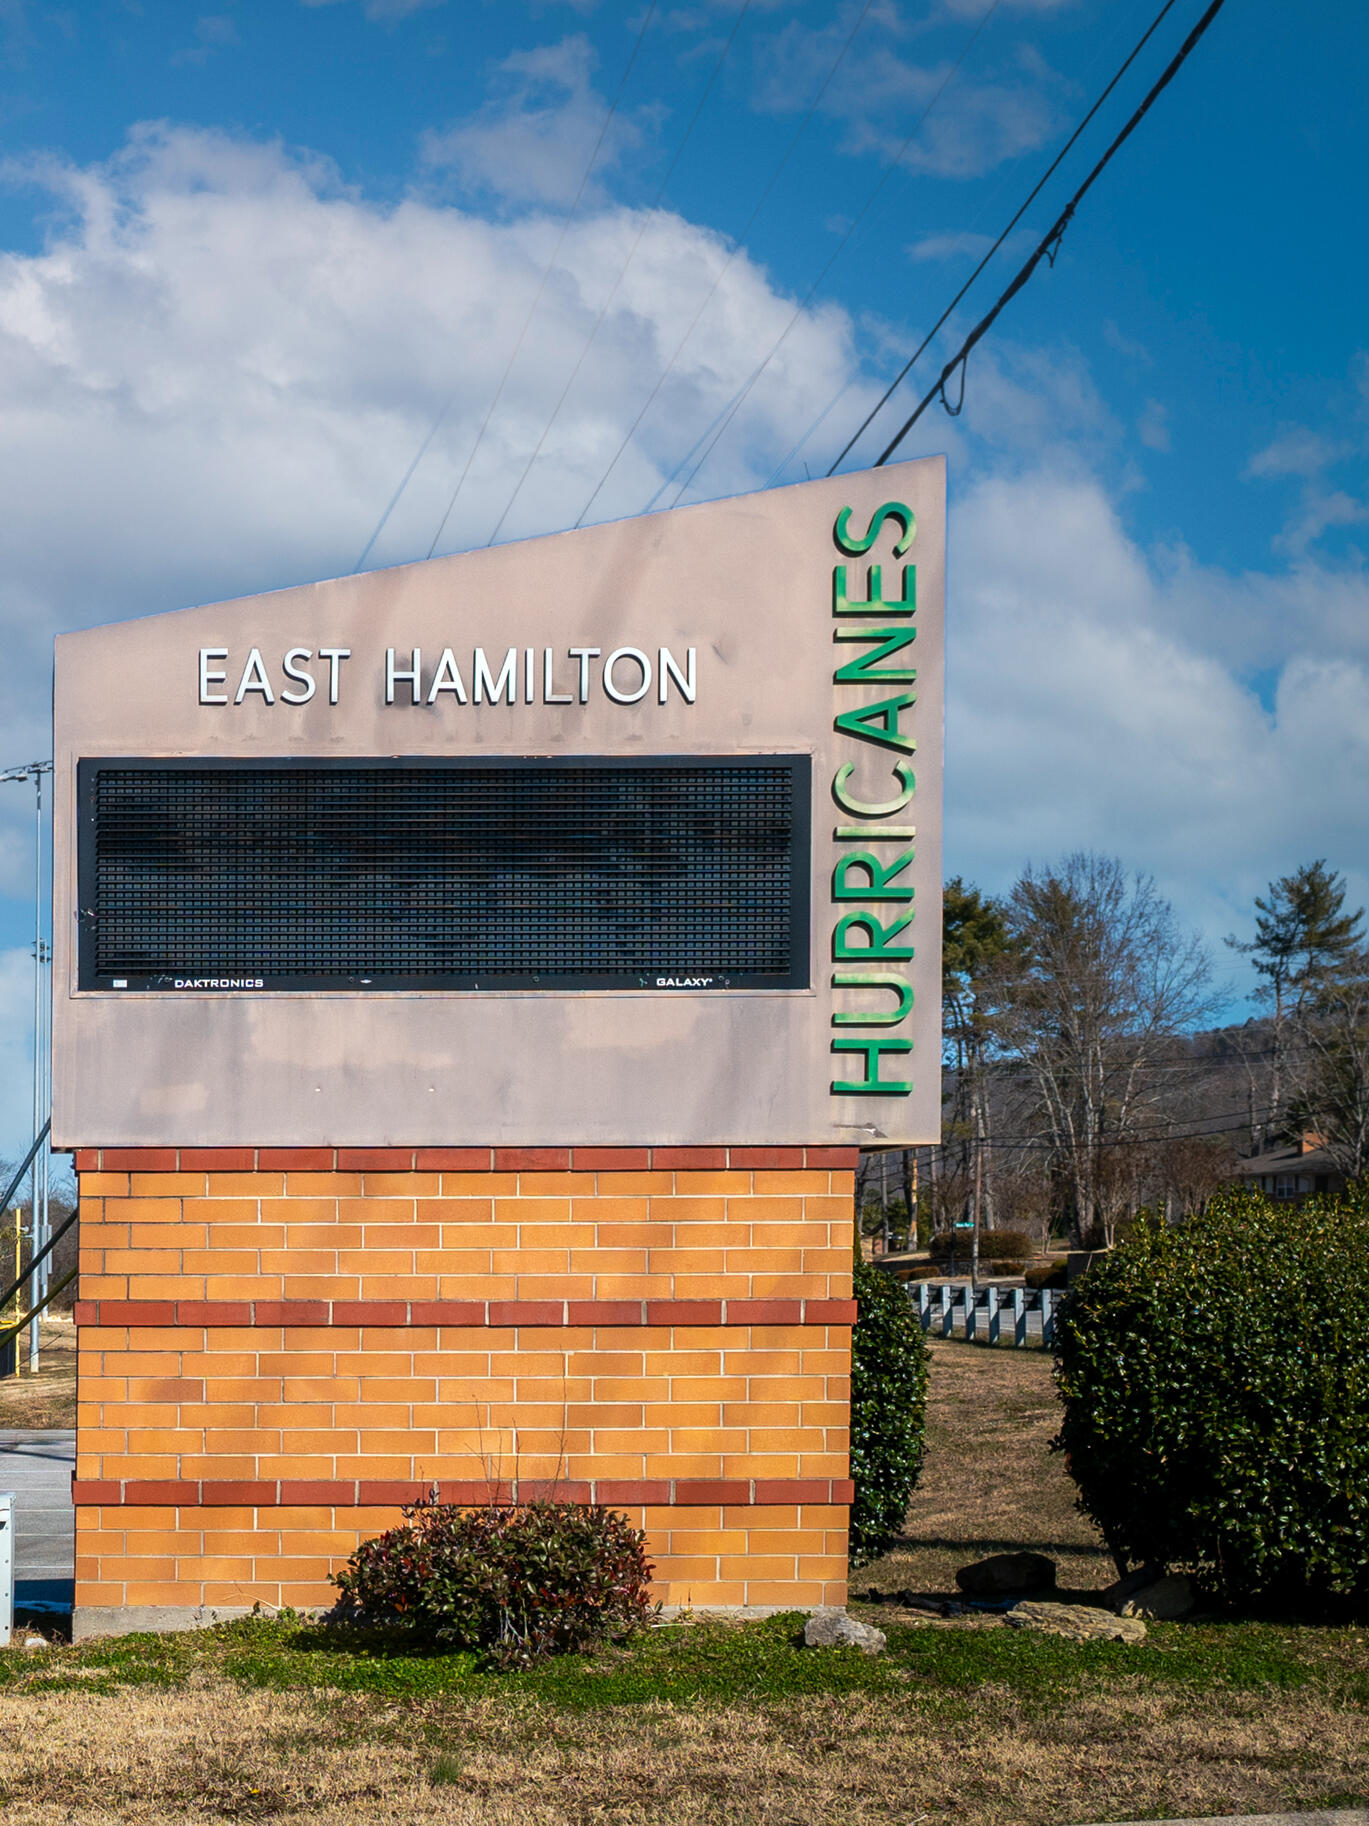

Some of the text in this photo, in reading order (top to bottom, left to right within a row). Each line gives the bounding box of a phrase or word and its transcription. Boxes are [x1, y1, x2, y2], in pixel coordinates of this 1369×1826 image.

[198, 646, 697, 706] EAST HAMILTON
[830, 501, 918, 1096] HURRICANES
[174, 979, 264, 988] DAKTRONICS
